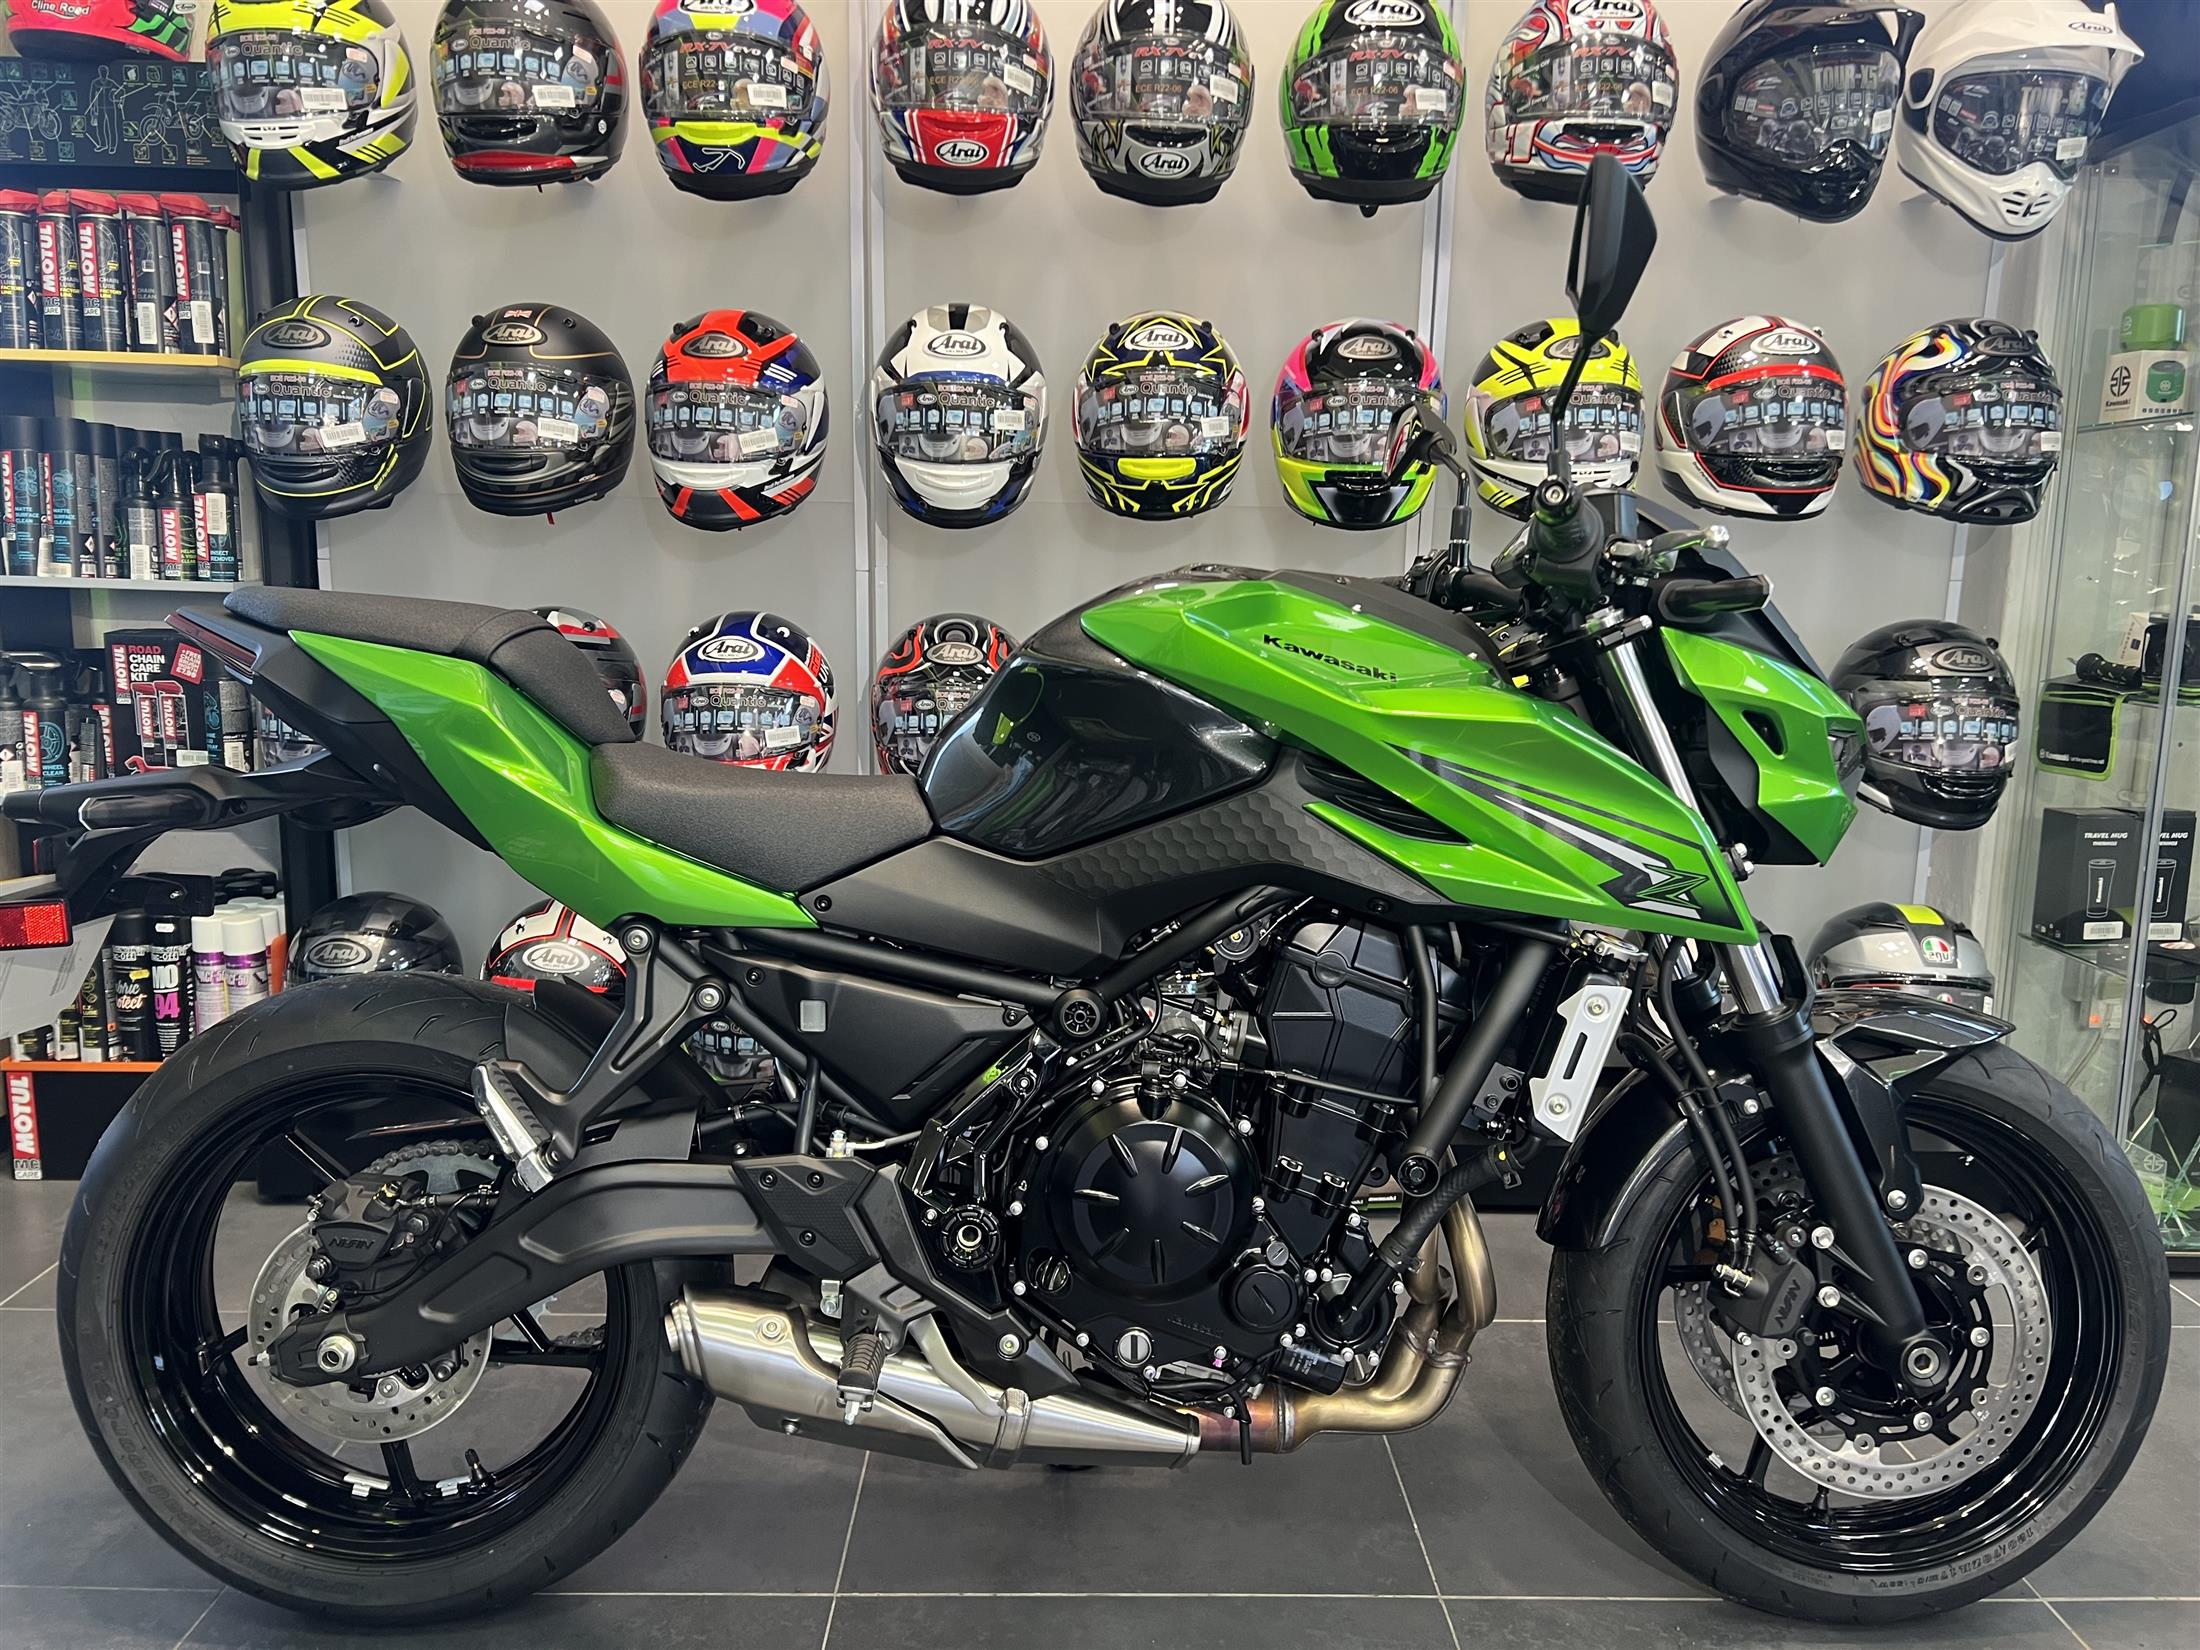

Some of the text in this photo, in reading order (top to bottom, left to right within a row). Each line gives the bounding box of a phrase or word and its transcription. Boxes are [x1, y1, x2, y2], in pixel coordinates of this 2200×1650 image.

[32, 0, 90, 15] Cline Road
[1352, 0, 1414, 18] Arai
[1571, 0, 1636, 15] Arai
[939, 144, 983, 159] Arai
[1142, 154, 1185, 170] Arai
[40, 224, 57, 294] MOTUL
[80, 225, 96, 295] MOTUL
[172, 227, 187, 297] MOTUL
[269, 324, 318, 341] Arai
[489, 324, 534, 340] Arai
[1134, 330, 1181, 345] Arai
[691, 335, 737, 350] Arai
[931, 335, 979, 351] Arai
[1346, 336, 1392, 353] Arai
[1766, 334, 1810, 350] Arai
[271, 383, 333, 398] Quantic
[488, 377, 547, 392] Quantic
[1140, 382, 1197, 397] Quantic
[689, 390, 747, 406] Quantic
[939, 392, 996, 407] Quantic
[163, 511, 178, 561] MOTUL
[128, 645, 161, 654] ROAD
[703, 641, 751, 658] Arai
[932, 644, 977, 660] Arai
[129, 654, 166, 665] CHAIN
[1263, 633, 1398, 684] Kawasaki
[113, 645, 129, 691] MOTUL
[130, 663, 161, 673] CARE
[130, 672, 149, 682] KIT
[710, 694, 768, 708] Quantic
[140, 698, 152, 738] MOTUL
[163, 698, 175, 737] MOTUL
[24, 714, 39, 774] MOTUL
[315, 944, 360, 960] Arai
[152, 964, 179, 989] MO
[154, 991, 181, 1019] 94
[10, 1075, 36, 1155] MOTUL
[14, 1159, 40, 1170] MC
[15, 1171, 41, 1179] CARE
